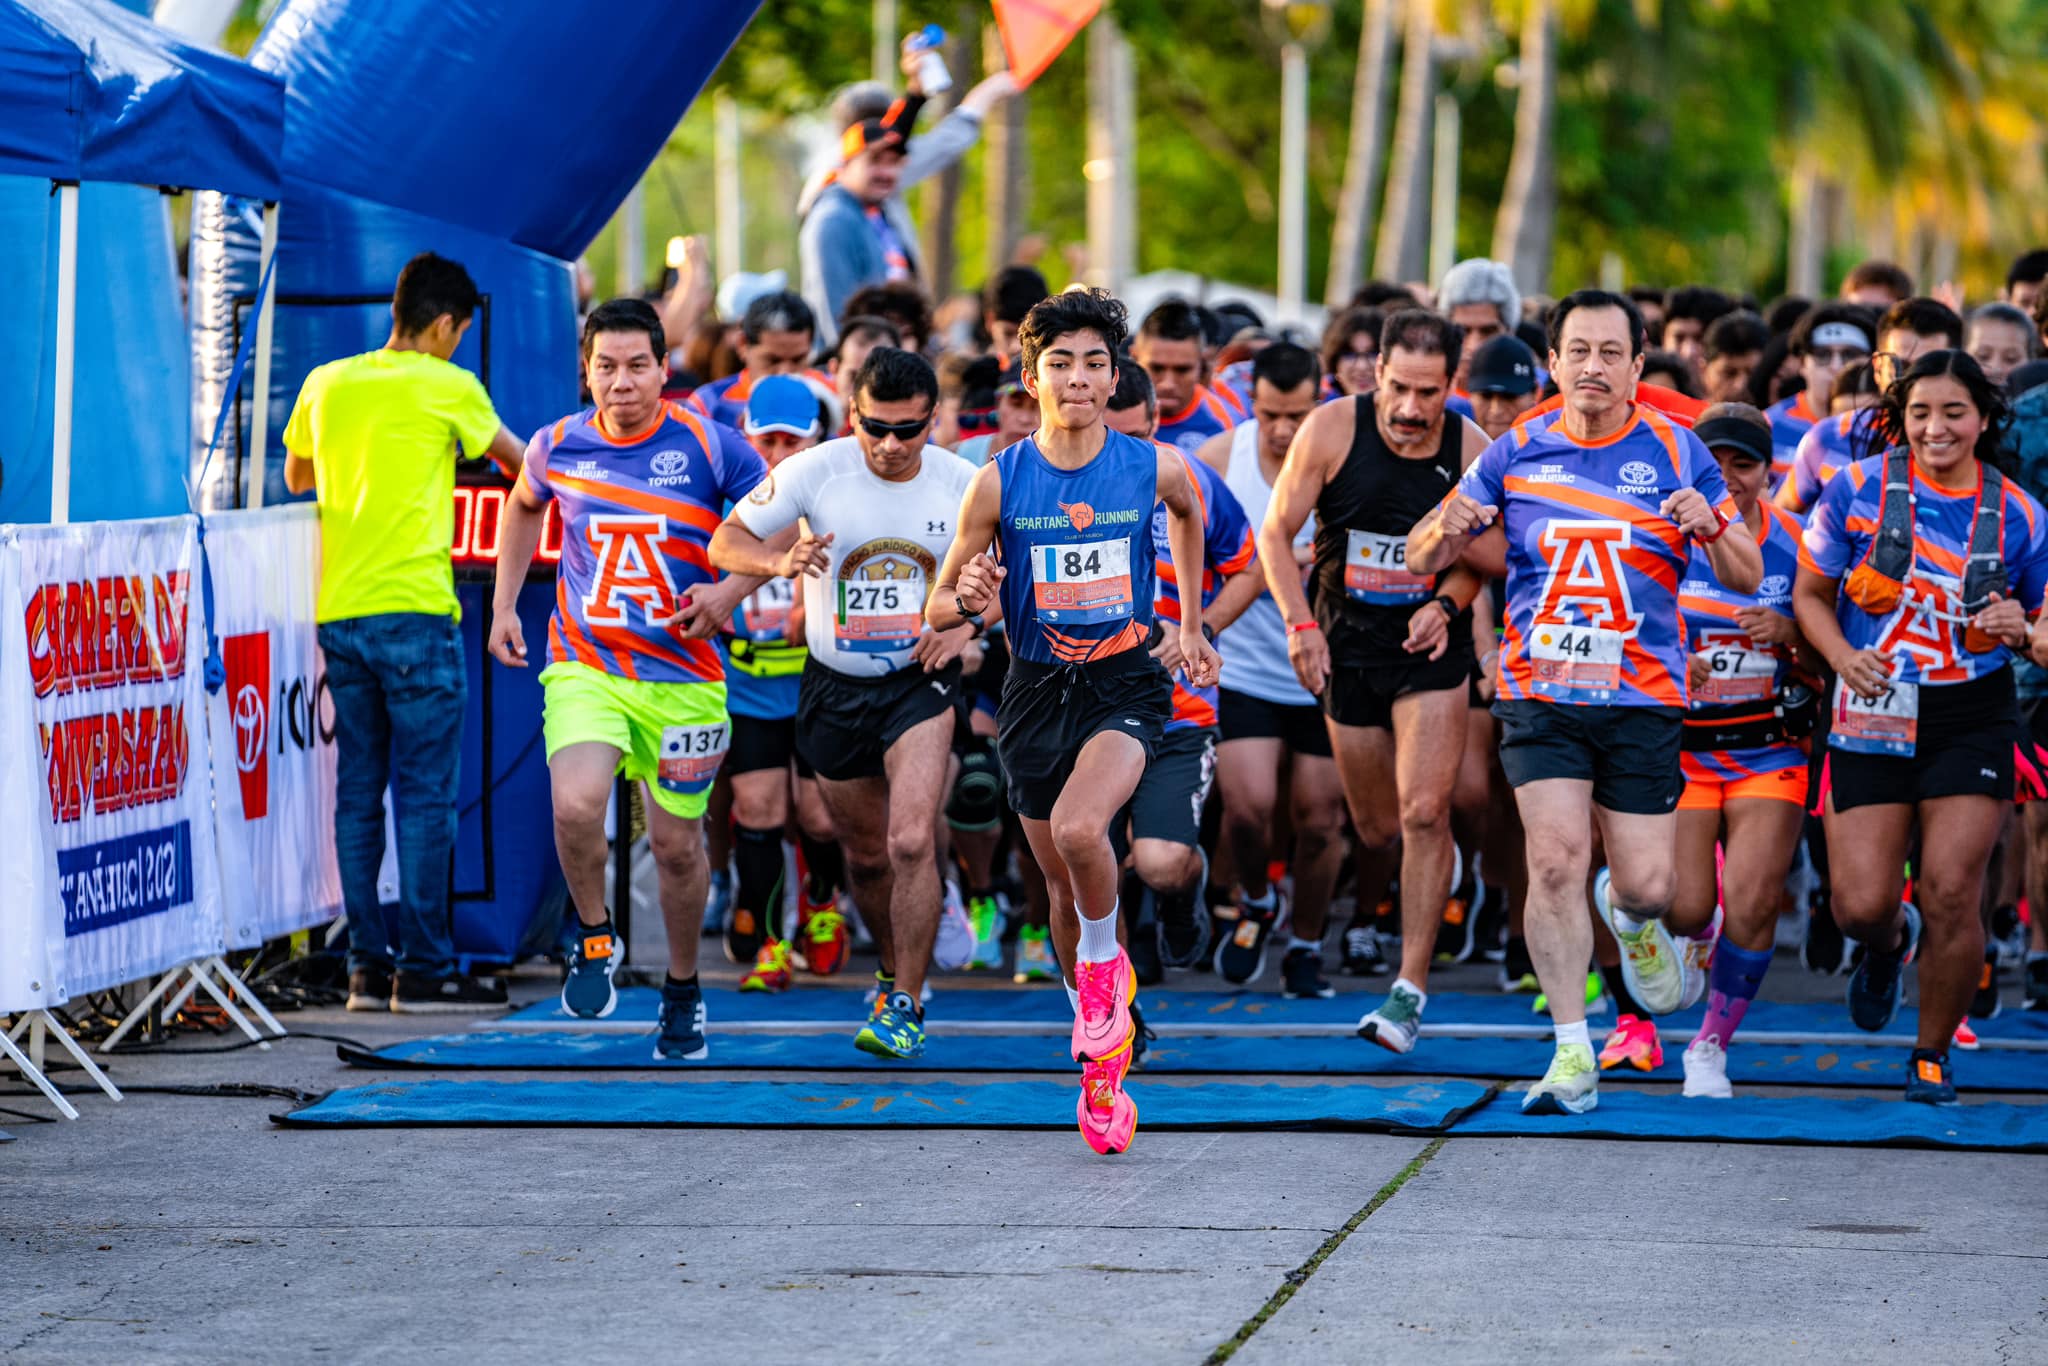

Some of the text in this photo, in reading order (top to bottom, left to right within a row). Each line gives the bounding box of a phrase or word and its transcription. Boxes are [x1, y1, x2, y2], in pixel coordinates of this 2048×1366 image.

[648, 474, 691, 487] TOYOTA
[1616, 485, 1659, 495] TOYOTA
[1015, 509, 1139, 530] SPARTANS RUNNING
[1064, 549, 1101, 577] 84
[1376, 541, 1406, 564] 76
[582, 514, 679, 627] A
[1530, 519, 1645, 641] A
[848, 586, 899, 610] 275
[1558, 633, 1592, 657] 44
[1711, 651, 1746, 673] 67
[681, 728, 724, 753] 137
